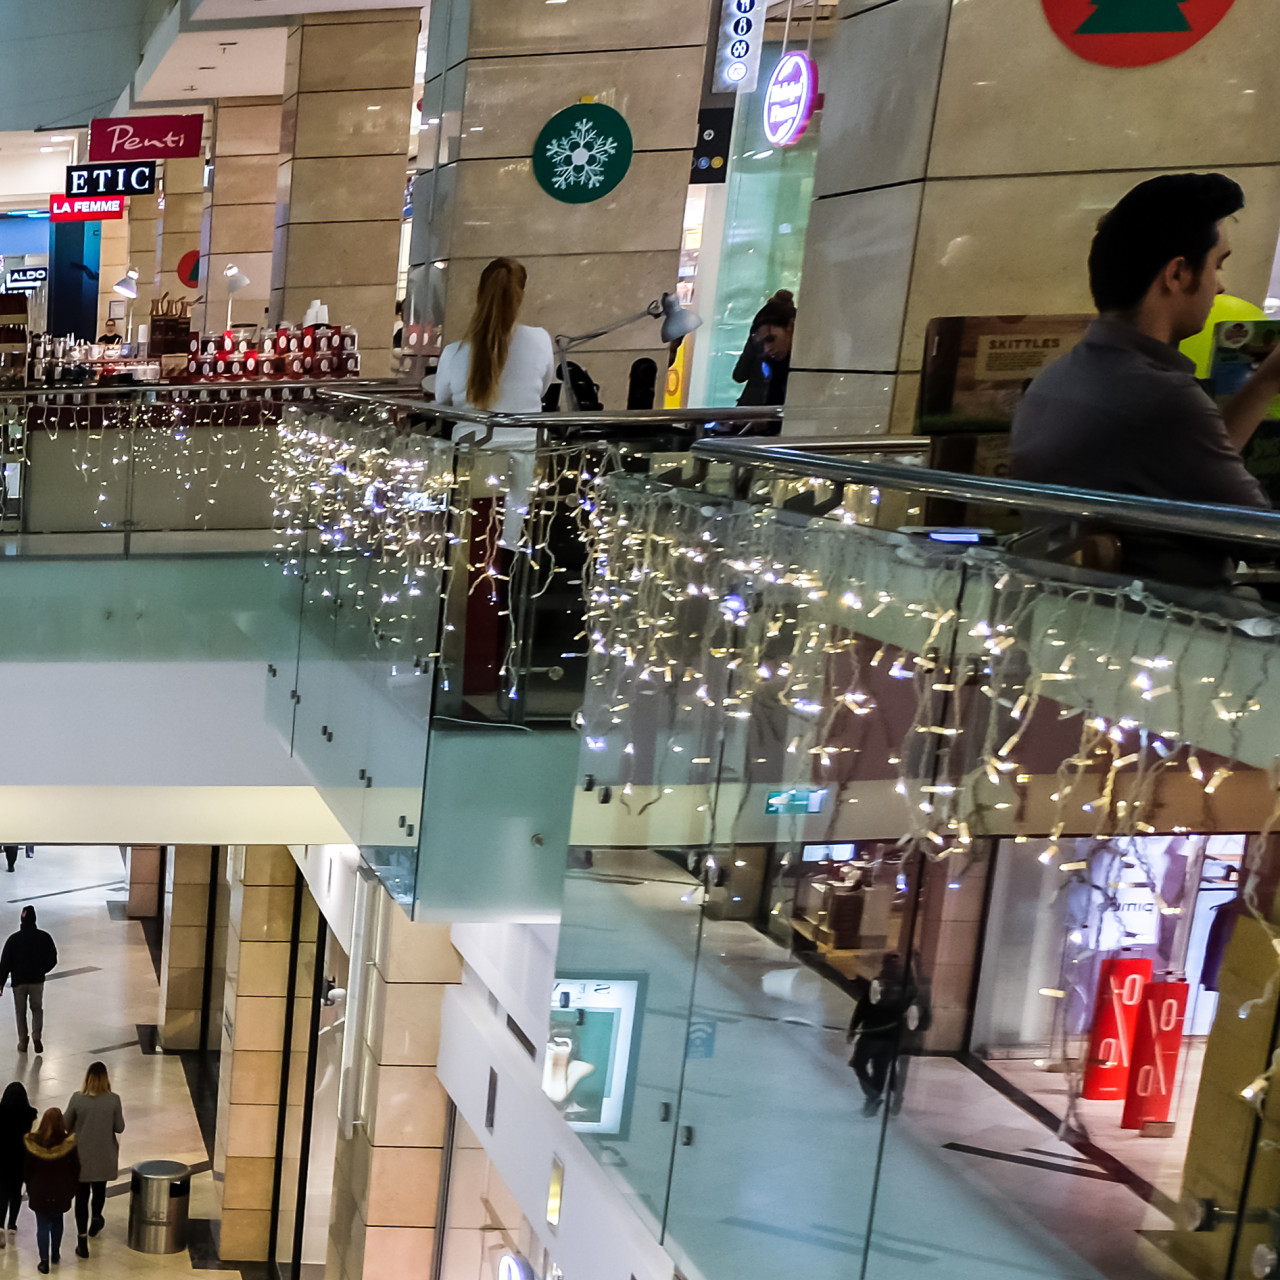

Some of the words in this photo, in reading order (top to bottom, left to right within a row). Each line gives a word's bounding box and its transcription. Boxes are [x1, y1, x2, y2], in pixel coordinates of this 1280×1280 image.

[107, 124, 185, 154] Penti
[70, 166, 150, 194] ETIC
[53, 202, 72, 214] LA
[74, 200, 121, 213] FEMME
[11, 269, 47, 281] ALDO
[988, 338, 1060, 350] SKITTLES
